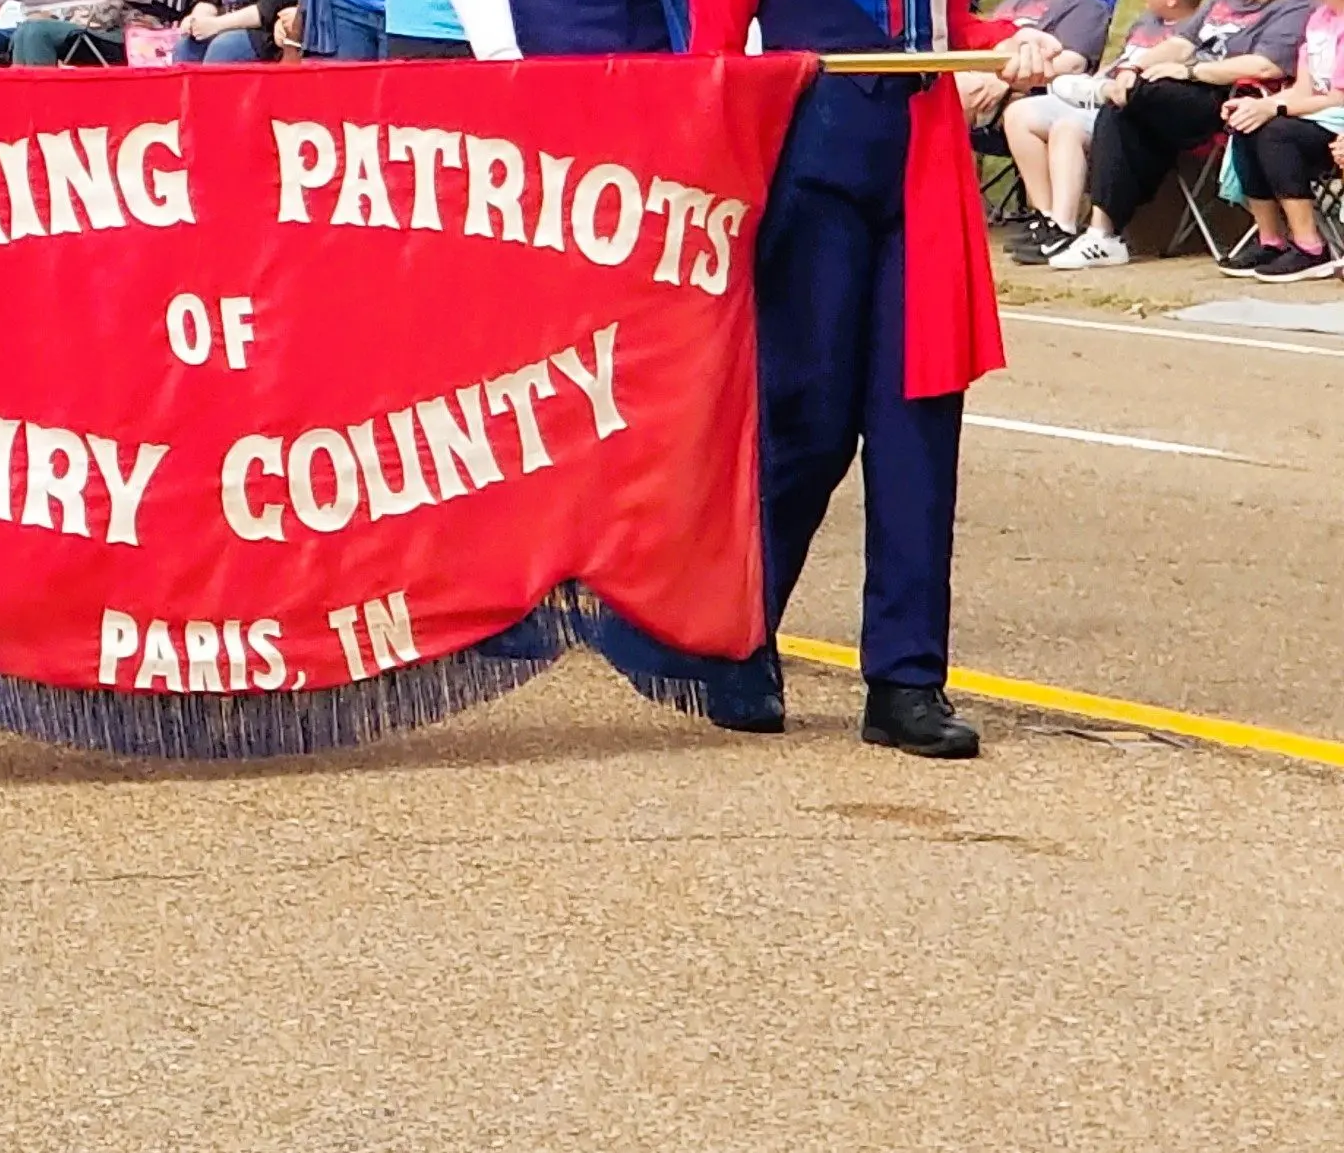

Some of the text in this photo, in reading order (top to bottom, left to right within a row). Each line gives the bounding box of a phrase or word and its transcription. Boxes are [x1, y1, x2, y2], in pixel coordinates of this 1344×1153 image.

[270, 119, 748, 297] PATRIOTS
[166, 293, 255, 370] OF
[221, 321, 628, 542] COUNTY
[98, 590, 422, 693] PARIS, TN
